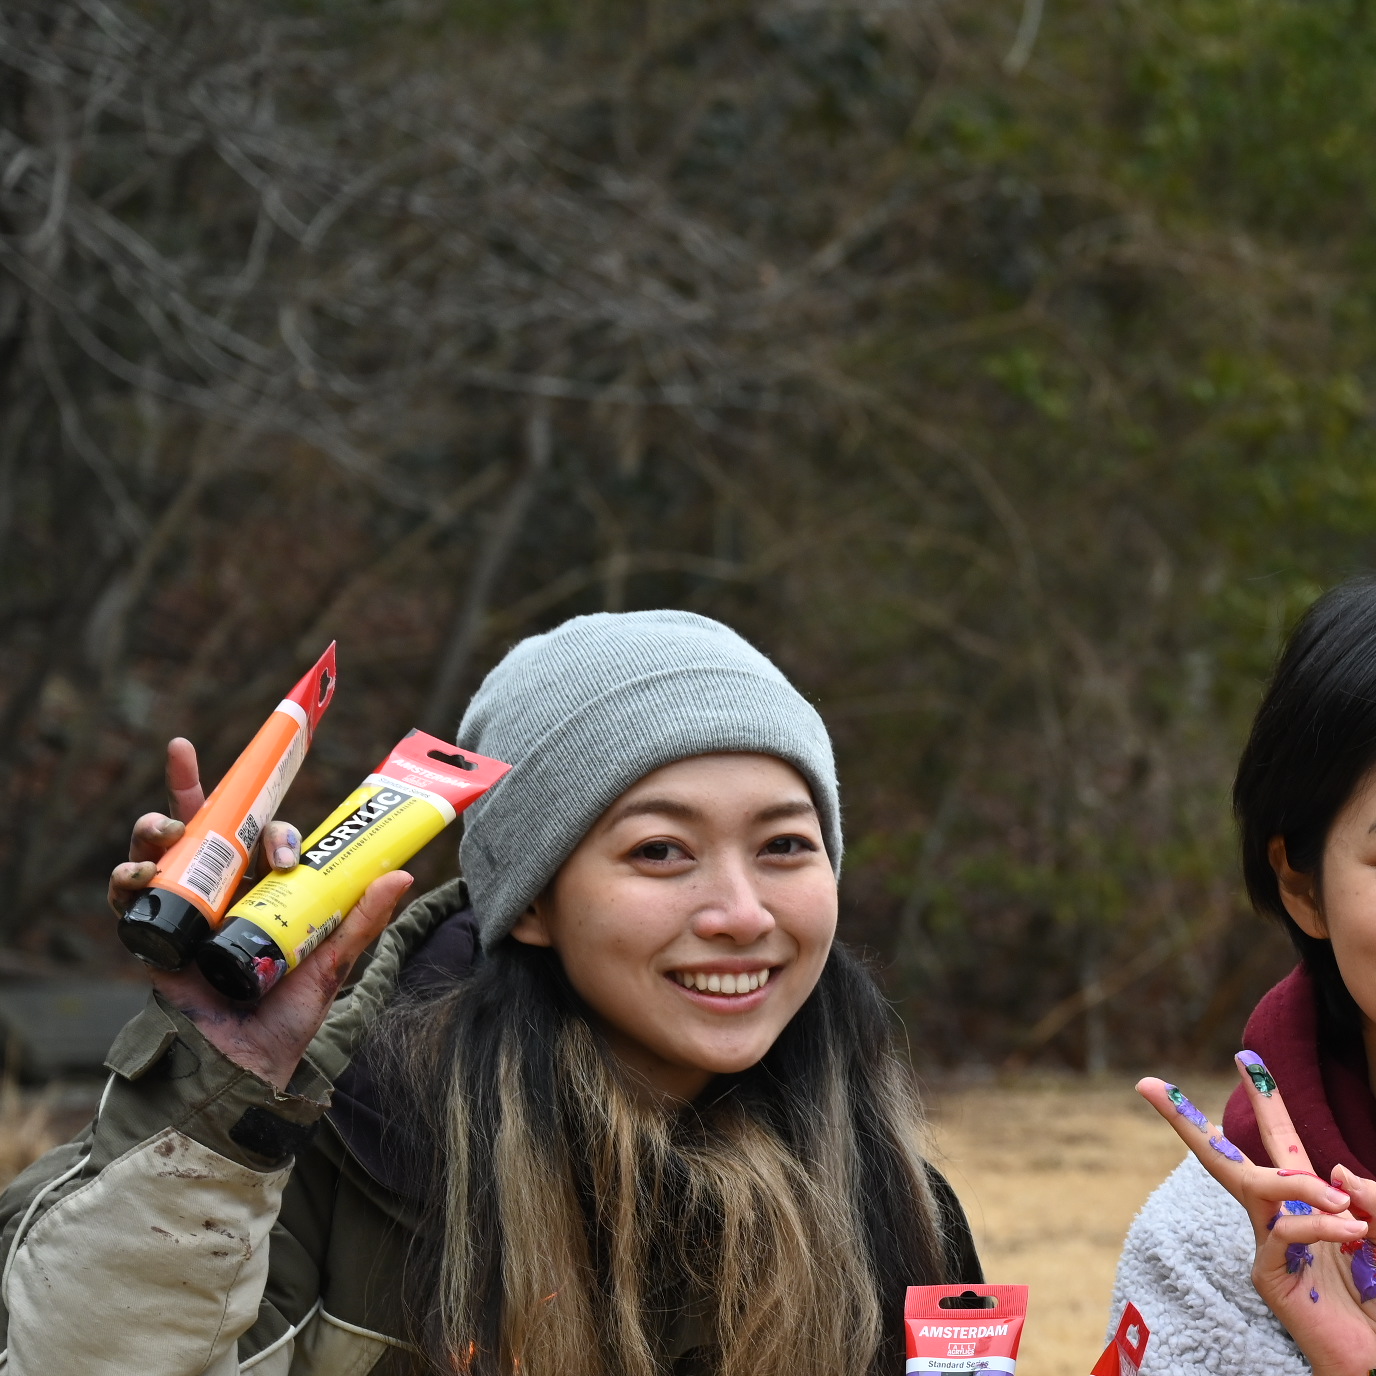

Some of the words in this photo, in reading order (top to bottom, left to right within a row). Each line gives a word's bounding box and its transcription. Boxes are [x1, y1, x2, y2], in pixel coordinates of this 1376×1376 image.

[391, 758, 471, 789] AMSTERDAM
[305, 791, 402, 865] ACRYLIC
[919, 1324, 1009, 1339] AMSTERDAM
[928, 1360, 964, 1369] Standard
